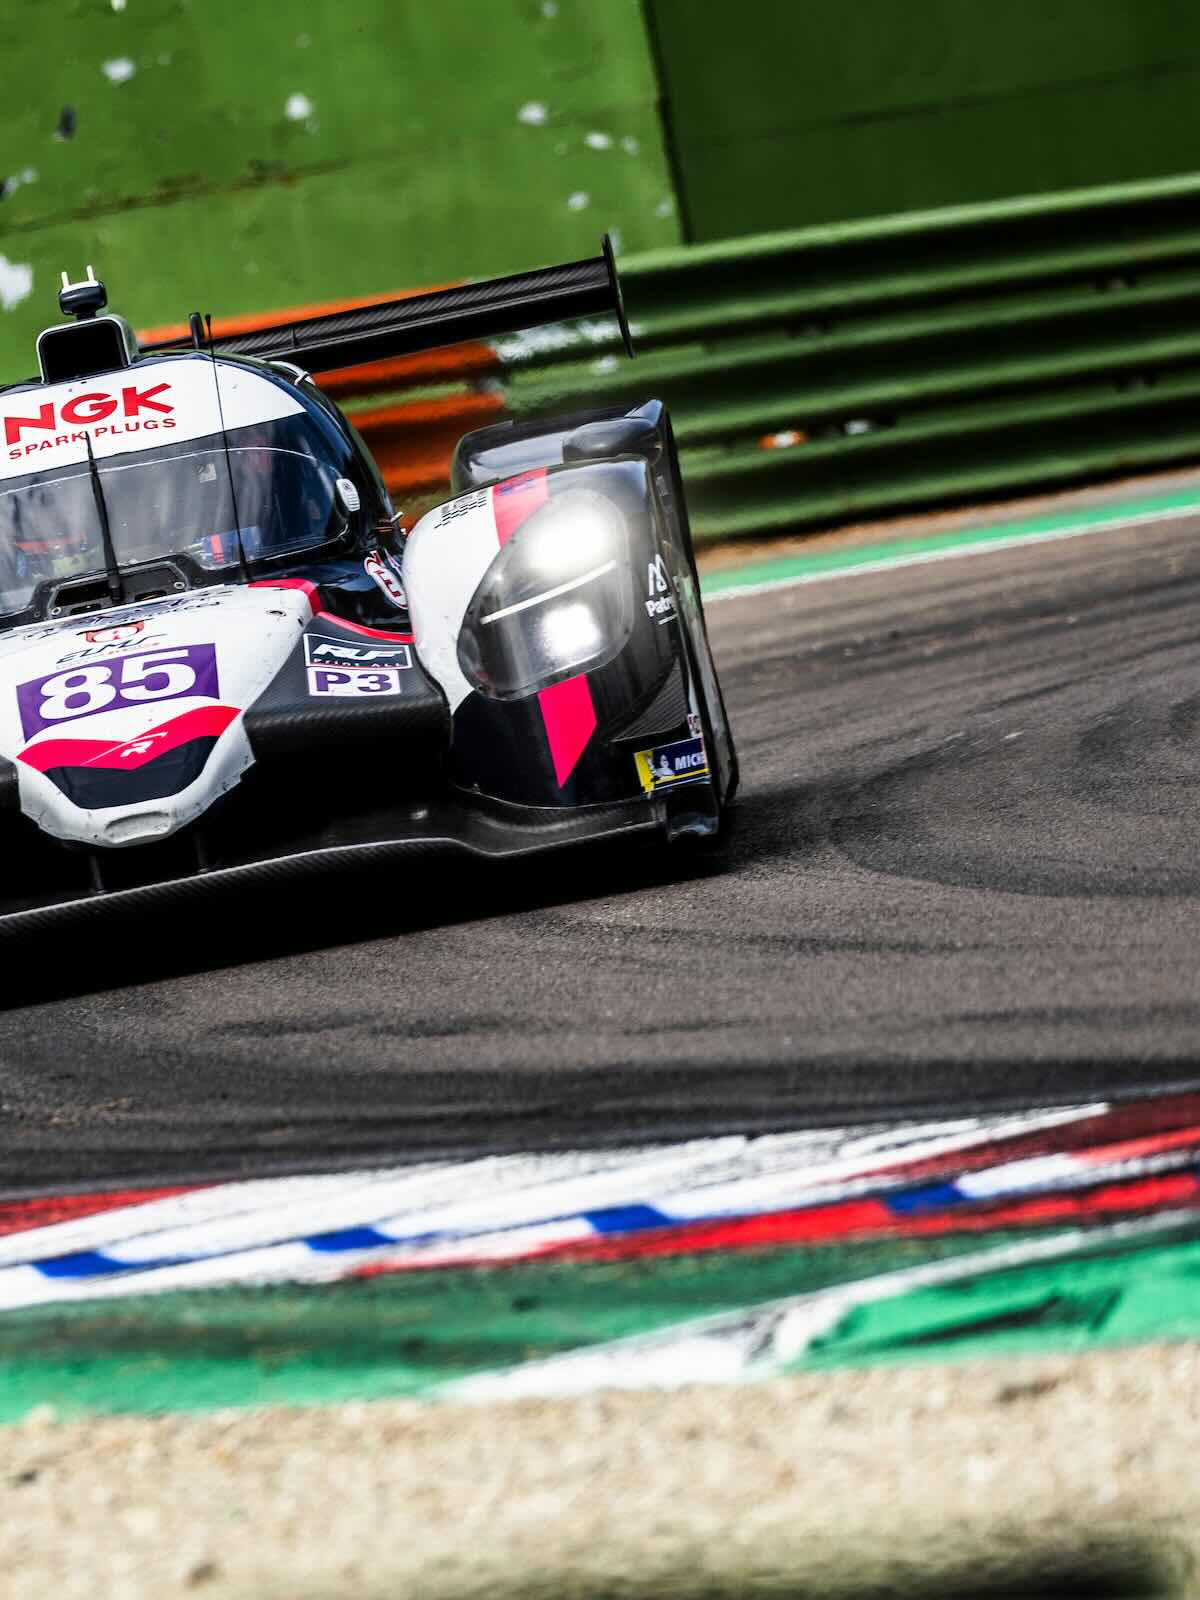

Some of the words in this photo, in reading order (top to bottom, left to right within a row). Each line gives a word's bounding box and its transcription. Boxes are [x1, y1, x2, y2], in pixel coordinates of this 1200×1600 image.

[4, 383, 175, 446] NGK
[8, 431, 87, 460] SPARK
[94, 418, 177, 437] PLUGS
[39, 649, 197, 720] 85
[315, 671, 393, 693] P3
